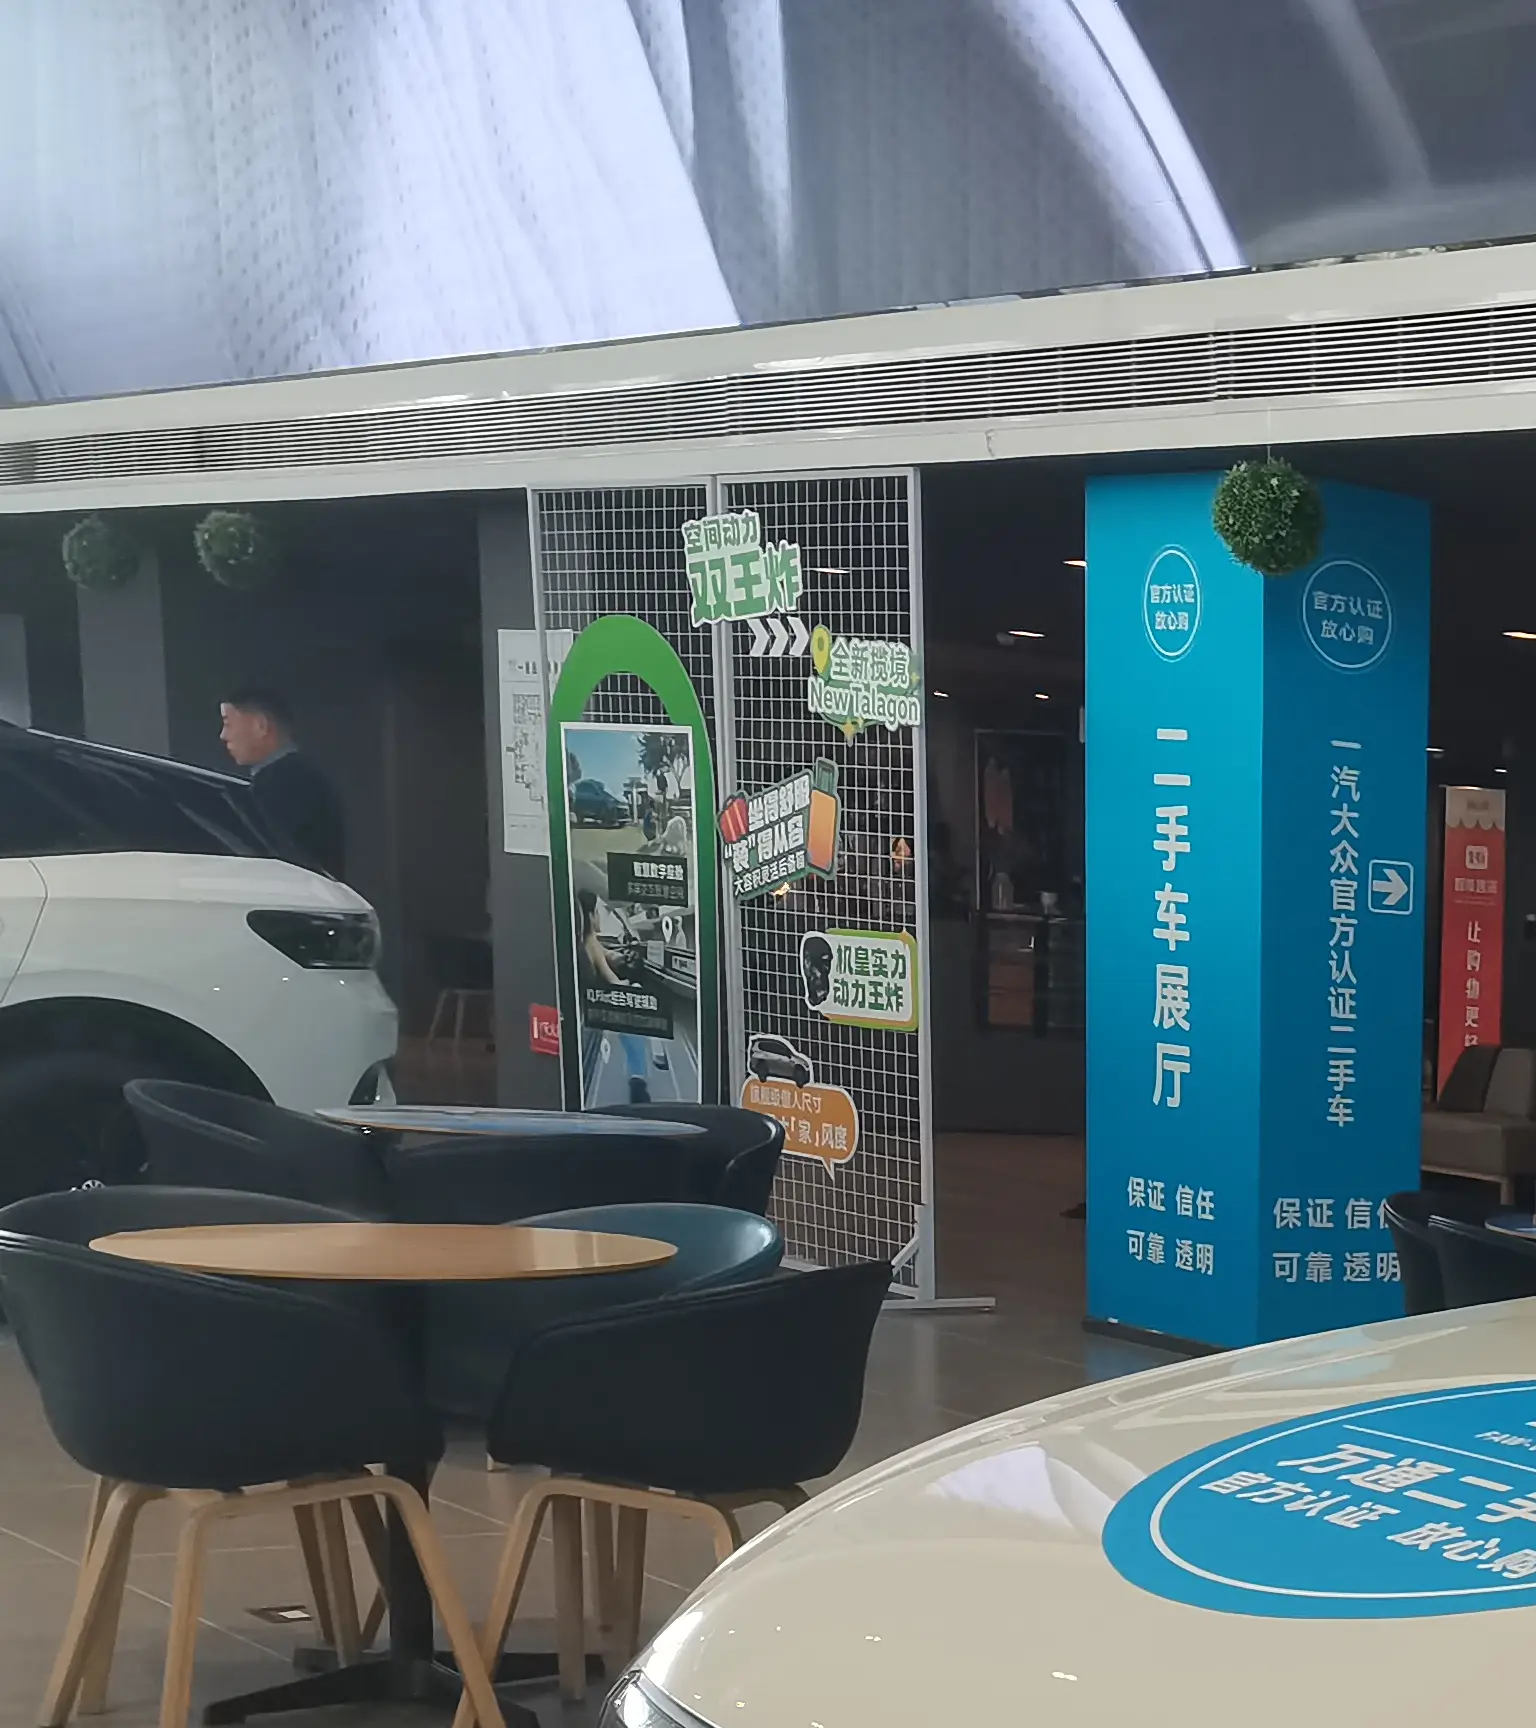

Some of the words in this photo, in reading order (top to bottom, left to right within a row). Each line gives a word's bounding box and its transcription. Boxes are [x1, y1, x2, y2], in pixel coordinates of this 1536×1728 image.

[686, 513, 760, 554] 空间动力
[690, 542, 801, 619] 双王炸
[1150, 583, 1195, 604] 官方认证
[1154, 610, 1189, 631] 放心购
[1313, 590, 1383, 620] 官方认证
[1320, 619, 1375, 646] 放心购
[831, 639, 909, 688] 全新揽境
[808, 678, 850, 711] New
[853, 688, 919, 727] Talagon
[748, 775, 810, 832] 坐得舒服
[1153, 728, 1191, 1108] 二手车展厅
[1326, 739, 1362, 1128] 一汽大众官方认证二手车
[836, 945, 907, 980] 机皇实力
[832, 979, 904, 1013] 动力王炸
[1127, 1176, 1166, 1214] 保证
[1175, 1184, 1216, 1221] 信任
[1273, 1197, 1334, 1230] 保证
[1126, 1229, 1166, 1265] 可靠
[1175, 1237, 1215, 1276] 透明
[1273, 1252, 1334, 1283] 可靠
[1199, 1470, 1402, 1529] 官方认证
